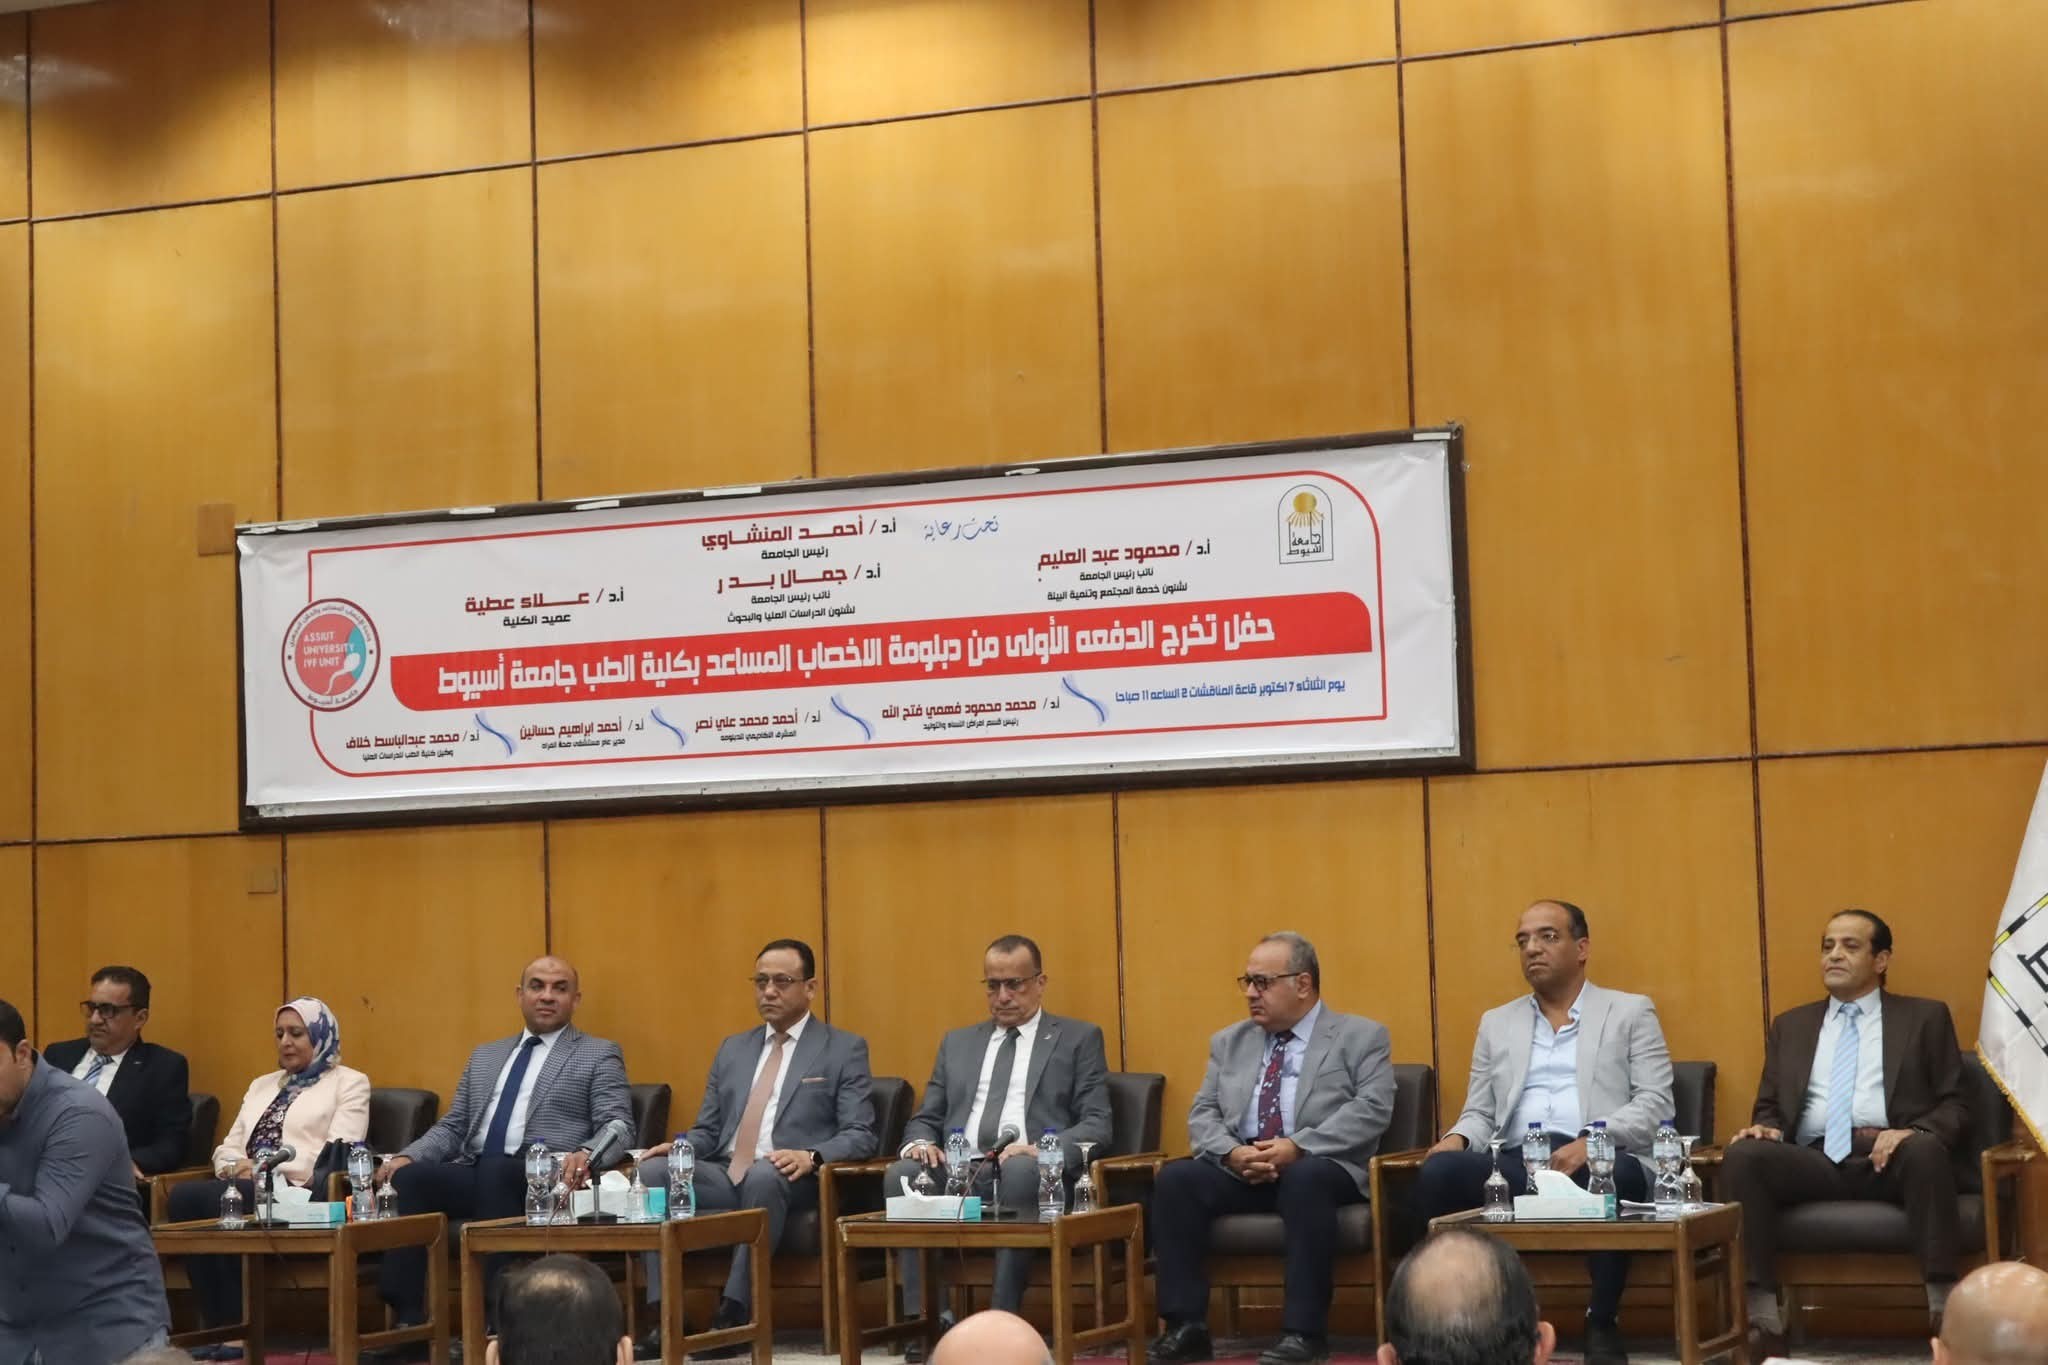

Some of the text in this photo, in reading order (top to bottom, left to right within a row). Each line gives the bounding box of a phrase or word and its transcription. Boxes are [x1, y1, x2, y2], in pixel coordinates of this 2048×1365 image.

[798, 514, 863, 540] أحمد
[924, 515, 998, 541] تحت رعاية
[702, 524, 792, 550] المنشاوي
[761, 546, 828, 560] رئيس الجامعة
[1038, 548, 1086, 571] العليم
[1092, 548, 1119, 566] عبد
[1124, 544, 1180, 564] محمود
[780, 568, 848, 588] جمال
[1080, 567, 1154, 582] نائب رئيس الجامعة
[751, 590, 830, 604] نائب رئيس الجامعة
[1070, 588, 1098, 600] وتنمية
[1100, 586, 1134, 600] المجتمع
[1136, 584, 1160, 595] خدمة
[465, 597, 514, 616] عطية
[520, 592, 590, 609] علاء
[503, 614, 571, 628] عميد الكلية
[727, 612, 762, 624] والبحوث
[764, 609, 786, 621] العليا
[789, 608, 826, 620] الدراسات
[304, 631, 334, 642] ASSIUT
[1076, 619, 1154, 654] الدفعه
[1161, 613, 1218, 657] تخرج
[1224, 610, 1275, 651] حفل
[1006, 615, 1069, 664] الأولى
[304, 643, 354, 656] UNIVERSITY
[888, 634, 962, 672] دبلومة
[967, 629, 1000, 667] من
[706, 643, 792, 677] المساعد
[510, 659, 577, 694] جامعة
[582, 654, 636, 692] الطب
[642, 649, 700, 688] بكلية
[438, 652, 504, 702] أسيوط
[1182, 688, 1188, 698] 2
[1189, 682, 1234, 698] المناقشات
[1234, 683, 1256, 695] قاعة
[1289, 682, 1294, 692] 7
[1328, 680, 1346, 692] يوم
[1142, 689, 1149, 700] 11
[882, 704, 900, 719] الله
[902, 704, 923, 720] فتح
[926, 702, 962, 719] فهمي
[964, 702, 1002, 717] محمود
[1005, 700, 1036, 712] محمد
[597, 716, 622, 732] أحمد
[716, 716, 736, 732] علي
[740, 714, 769, 728] محمد
[772, 708, 798, 724] أحمد
[520, 724, 555, 740] حسانين
[695, 716, 712, 733] نصر
[346, 736, 371, 749] خلاف
[429, 732, 460, 744] محمد
